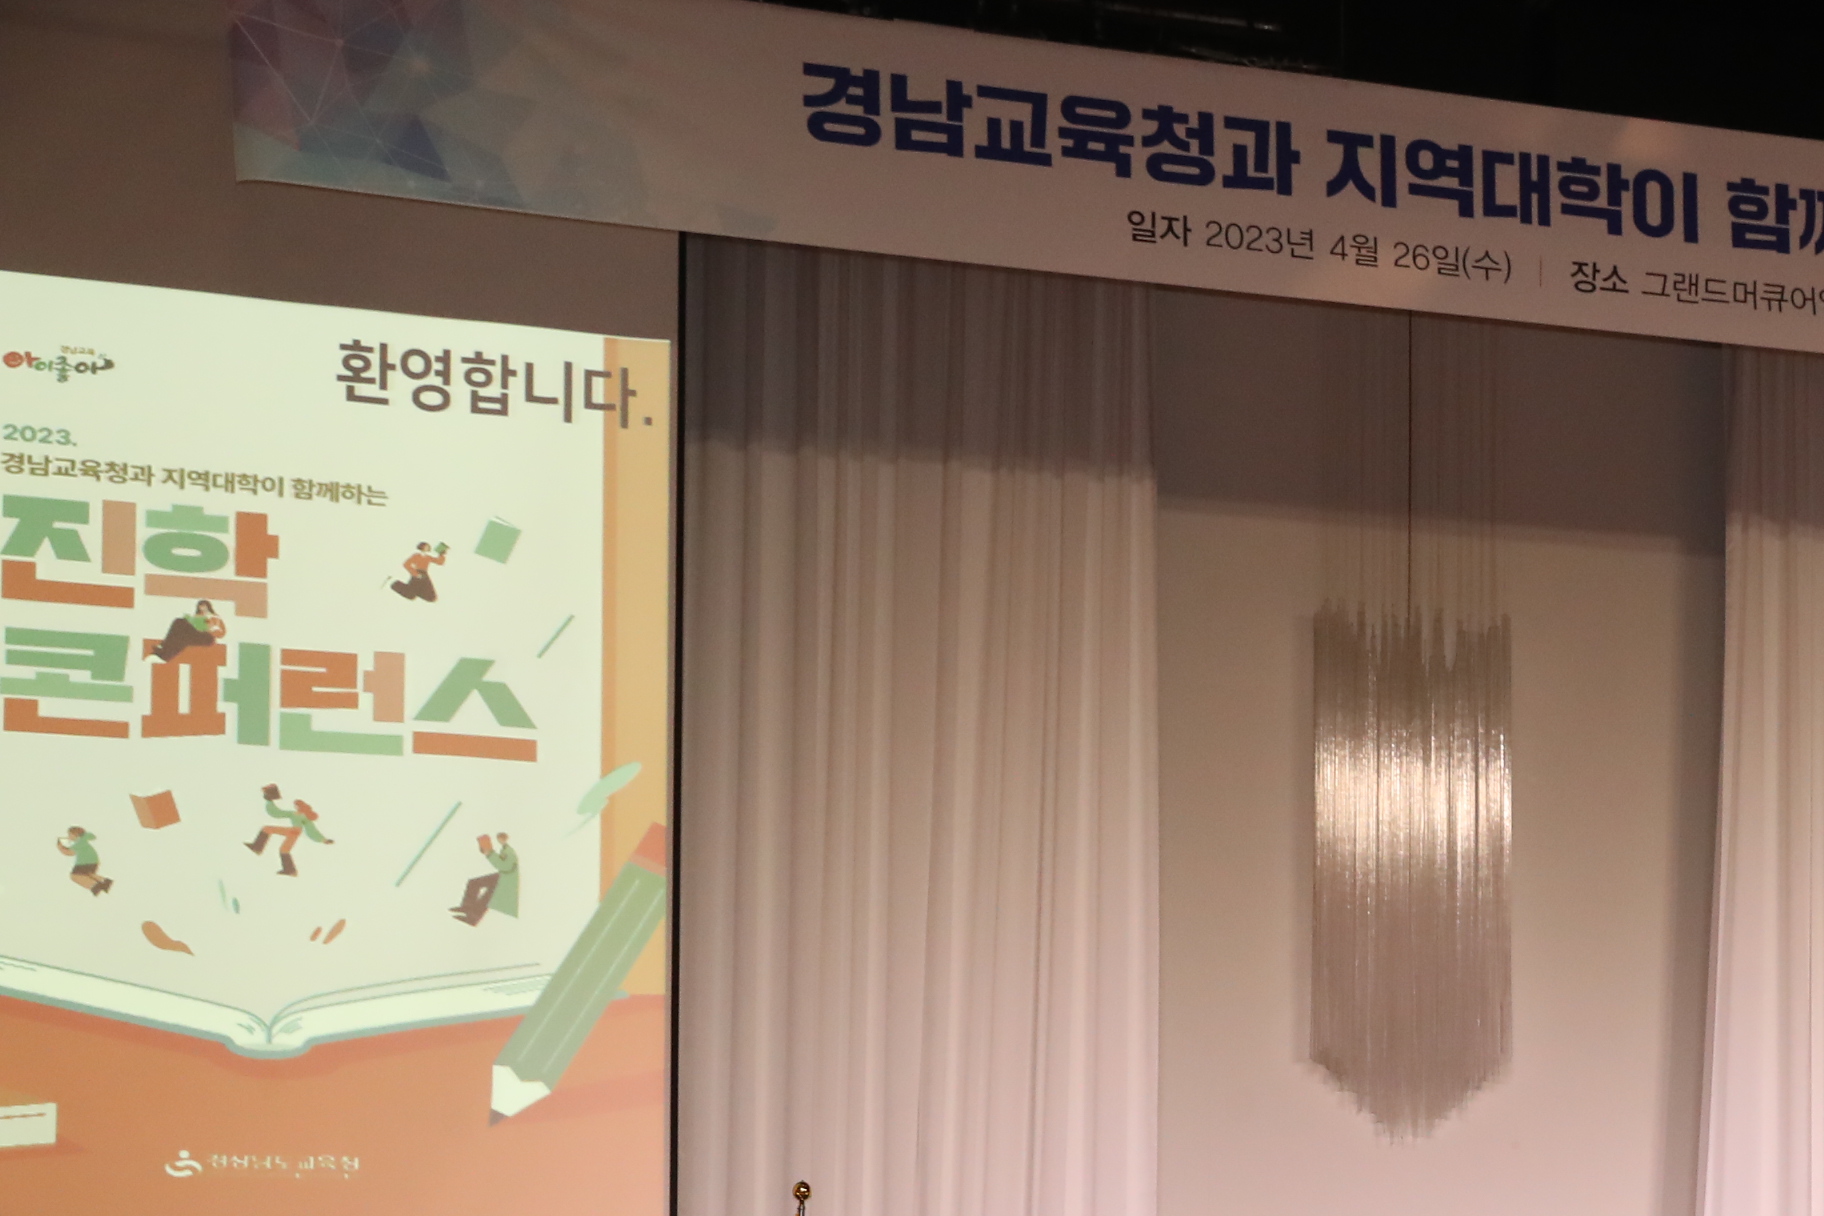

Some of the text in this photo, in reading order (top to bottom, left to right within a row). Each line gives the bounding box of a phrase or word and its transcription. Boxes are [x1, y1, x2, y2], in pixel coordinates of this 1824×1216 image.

[802, 62, 1301, 196] 경남교육청과
[1326, 129, 1697, 245] 지역대학이
[1126, 209, 1192, 249] 일자
[1205, 218, 1316, 263] 2023년
[1329, 232, 1380, 267] 4월
[1393, 240, 1513, 286] 26일(수)
[1570, 260, 1631, 297] 장소
[336, 338, 654, 430] 환영합니다.
[0, 453, 389, 507] 경남교육청과 지역대학이 함께하는
[2, 424, 78, 447] 2023.
[0, 494, 280, 619] 진학
[0, 626, 538, 763] 콘퍼런스
